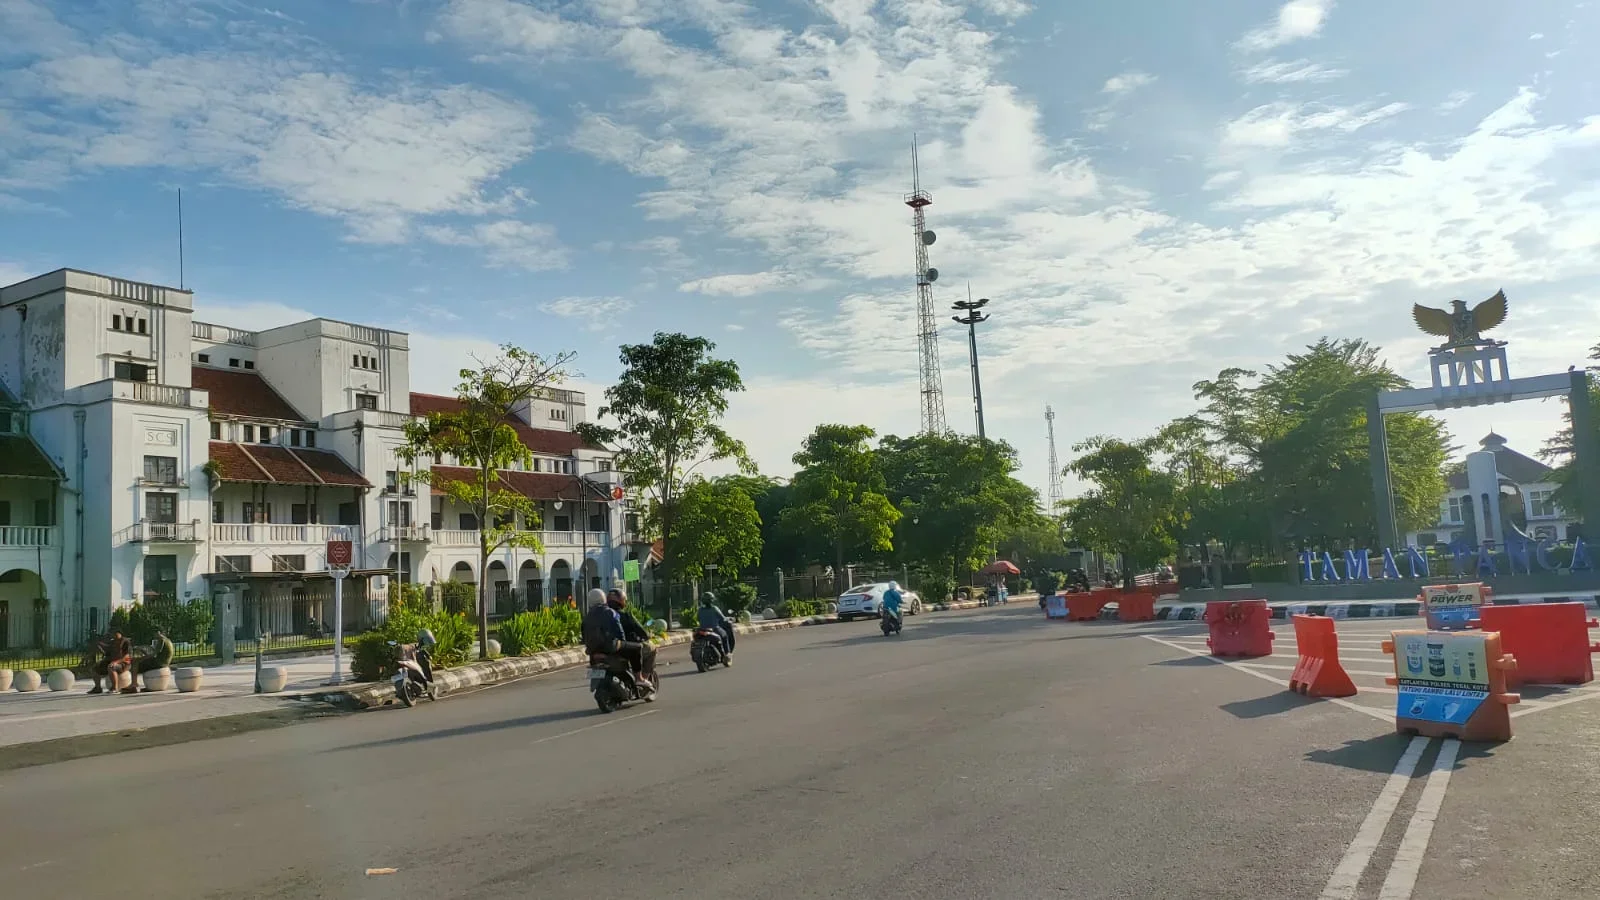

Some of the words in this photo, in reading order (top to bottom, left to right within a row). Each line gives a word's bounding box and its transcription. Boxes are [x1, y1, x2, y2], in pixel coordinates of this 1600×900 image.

[147, 431, 173, 443] SCS
[1303, 545, 1430, 581] TAMAN
[1450, 536, 1592, 578] PANCA
[1431, 594, 1473, 604] POWER
[1422, 687, 1443, 695] RAMBU
